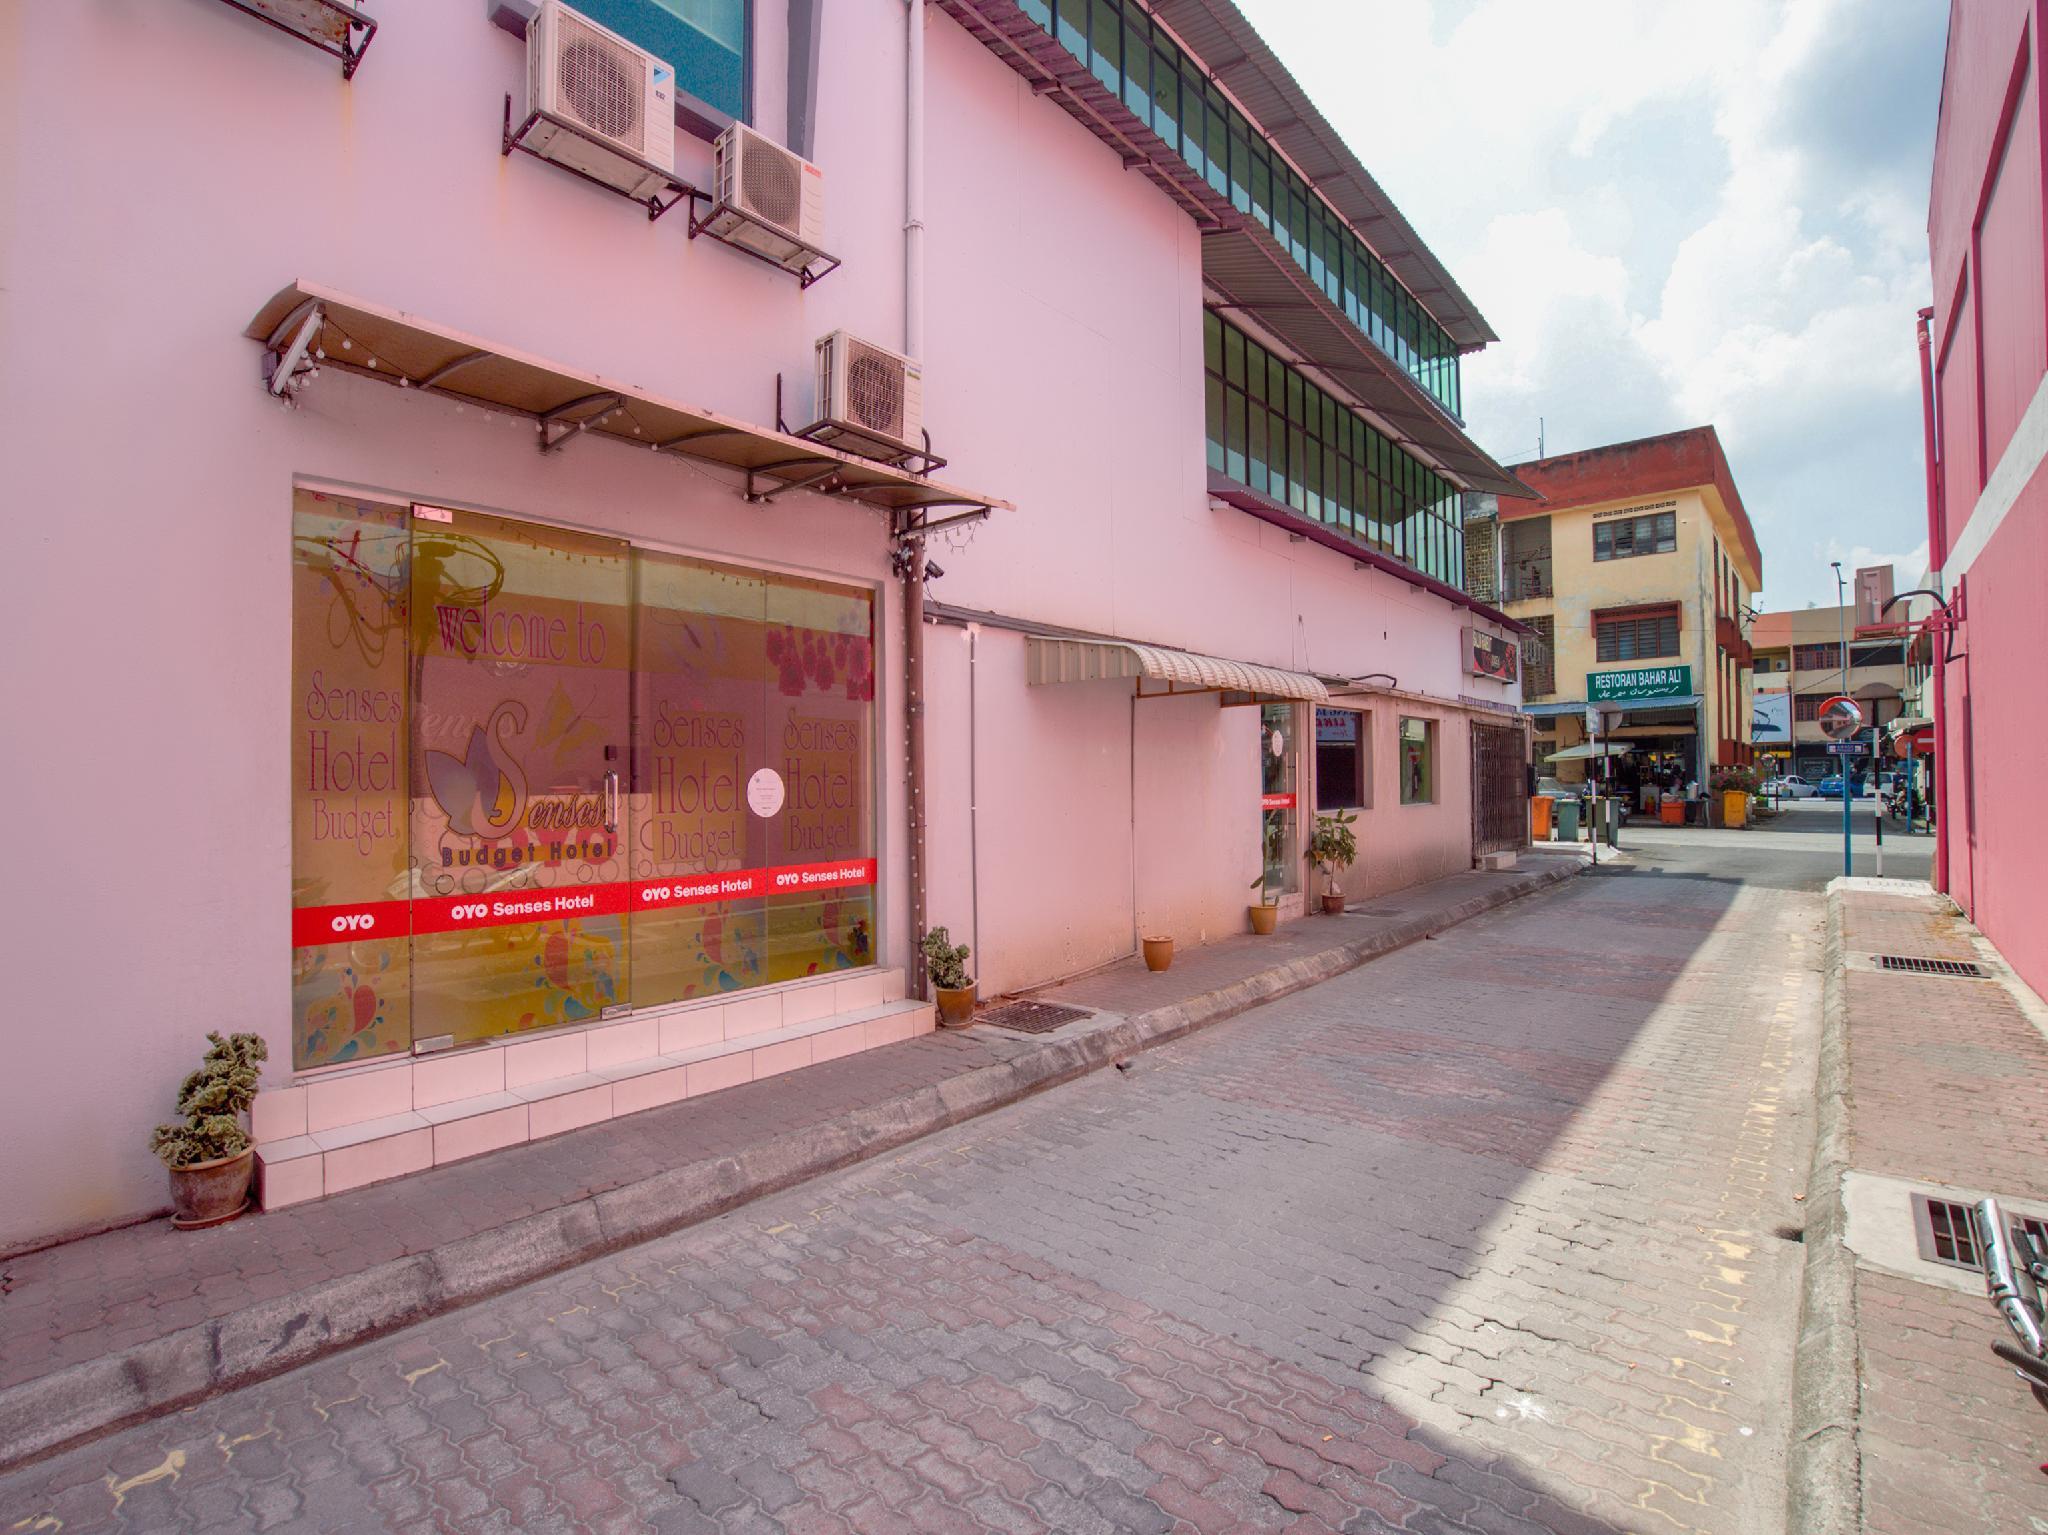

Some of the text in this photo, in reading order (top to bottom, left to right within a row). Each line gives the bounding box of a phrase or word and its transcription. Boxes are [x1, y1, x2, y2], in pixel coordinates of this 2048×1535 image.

[434, 584, 607, 664] welcome to
[307, 670, 403, 723] Senses
[1595, 669, 1681, 688] RESTORAN BAHAR ALI
[653, 699, 744, 749] Senses
[784, 706, 858, 753] Senses
[308, 730, 399, 792] Hotel
[656, 752, 742, 814] Hotel
[785, 755, 854, 810] Hotel
[313, 794, 396, 856] Budget
[661, 816, 738, 873] Budget
[790, 813, 853, 863] Budget
[442, 838, 613, 867] Budget Hotel
[776, 866, 865, 886] OYO Senses Hotel
[451, 894, 594, 920] OYO Senses Hotel
[642, 878, 752, 901] OYO Senses Hotel
[331, 914, 375, 932] OYO
